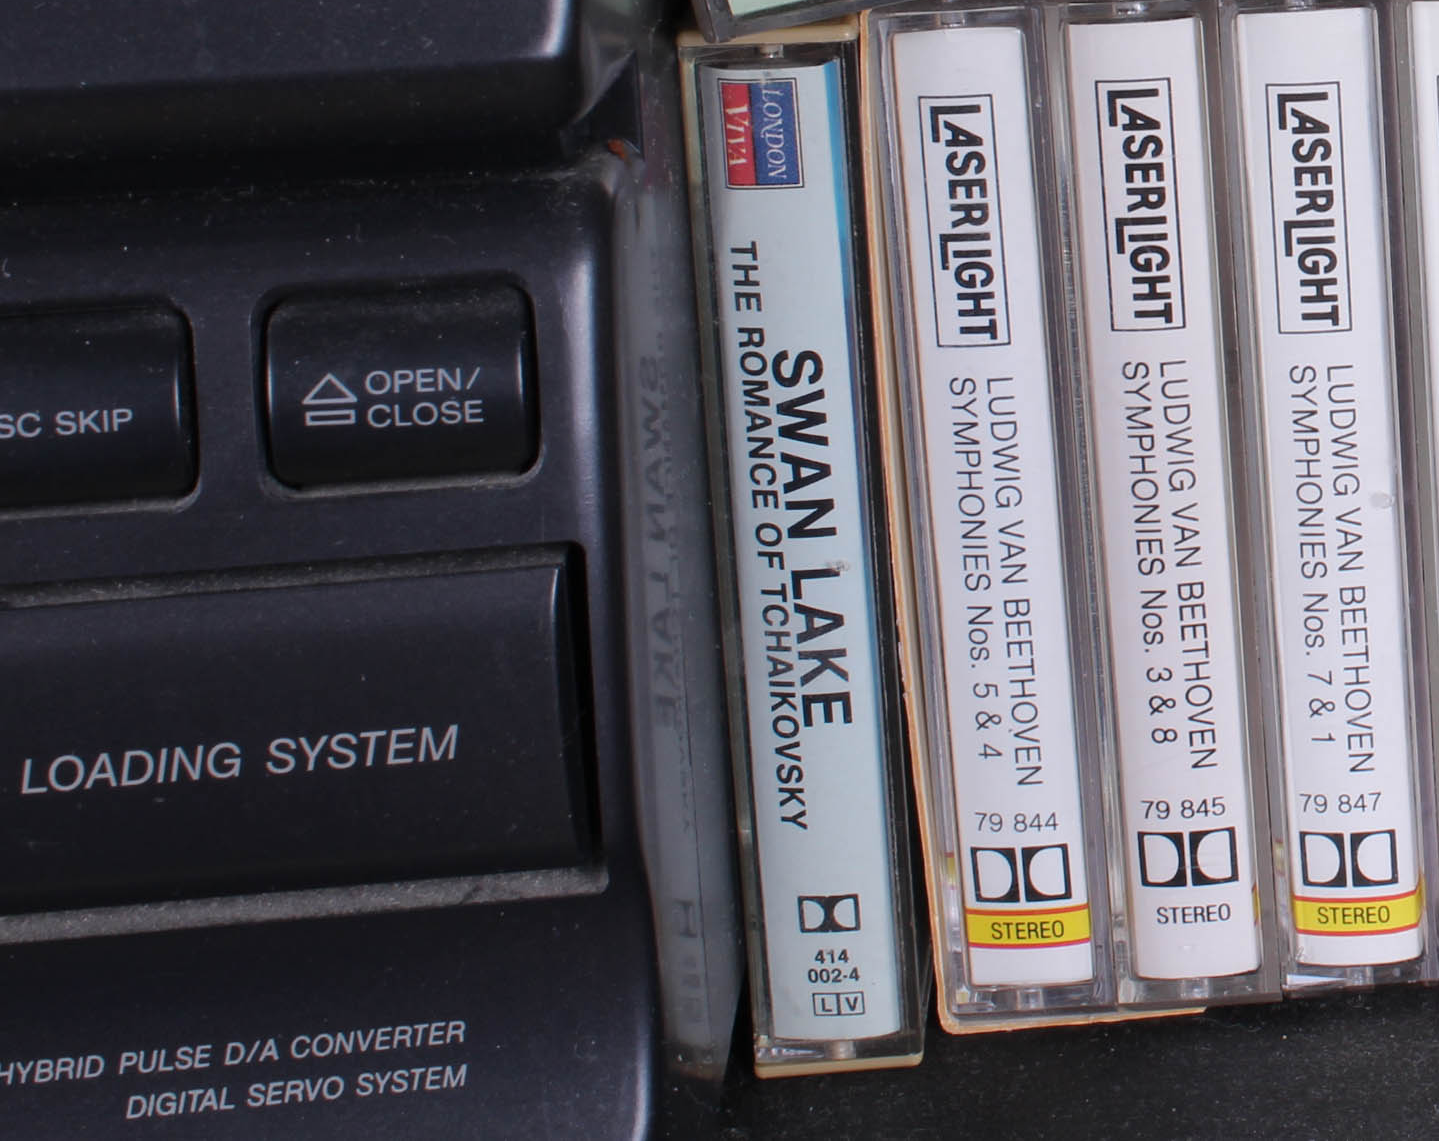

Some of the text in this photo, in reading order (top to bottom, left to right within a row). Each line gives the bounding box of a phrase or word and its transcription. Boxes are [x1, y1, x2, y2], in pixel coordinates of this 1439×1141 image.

[724, 104, 749, 167] VIVA
[758, 85, 787, 180] LONDON
[929, 104, 998, 341] LASERLIGHT
[1106, 88, 1173, 325] LASERLIGHT
[1276, 91, 1340, 327] LASERLIGHT
[364, 367, 481, 394] OPEN/
[55, 408, 133, 436] SKIP
[366, 399, 484, 429] CLOSE
[730, 240, 808, 830] THE ROMANCE OF TCHAIKOVSKY
[772, 350, 853, 727] SWAN LAKE
[949, 377, 994, 669] SYMPHONIES Nos.
[1121, 360, 1168, 654] SYMPHONIES Nos.
[1289, 365, 1330, 657] SYMPHONIES Nos.
[986, 376, 1044, 787] LUDWIG VAN BEETHOVEN
[1158, 359, 1218, 770] LUDWIG VAN BEETHOVEN
[1326, 364, 1376, 774] LUDWIG VAN BEETHOVEN
[20, 724, 459, 795] LOADING SYSTEM
[974, 811, 1060, 833] 79 844
[1140, 796, 1226, 820] 79 845
[1300, 792, 1382, 814] 79 847
[990, 920, 1065, 941] STEREO
[1156, 903, 1232, 926] STEREO
[1316, 905, 1391, 925] STEREO
[807, 967, 860, 983] 002-4
[814, 949, 849, 965] 414
[0, 1020, 466, 1085] HYBRID PULSE D/A CONVERTER
[125, 1064, 467, 1120] DIGITAL SERVO SYSTEM
